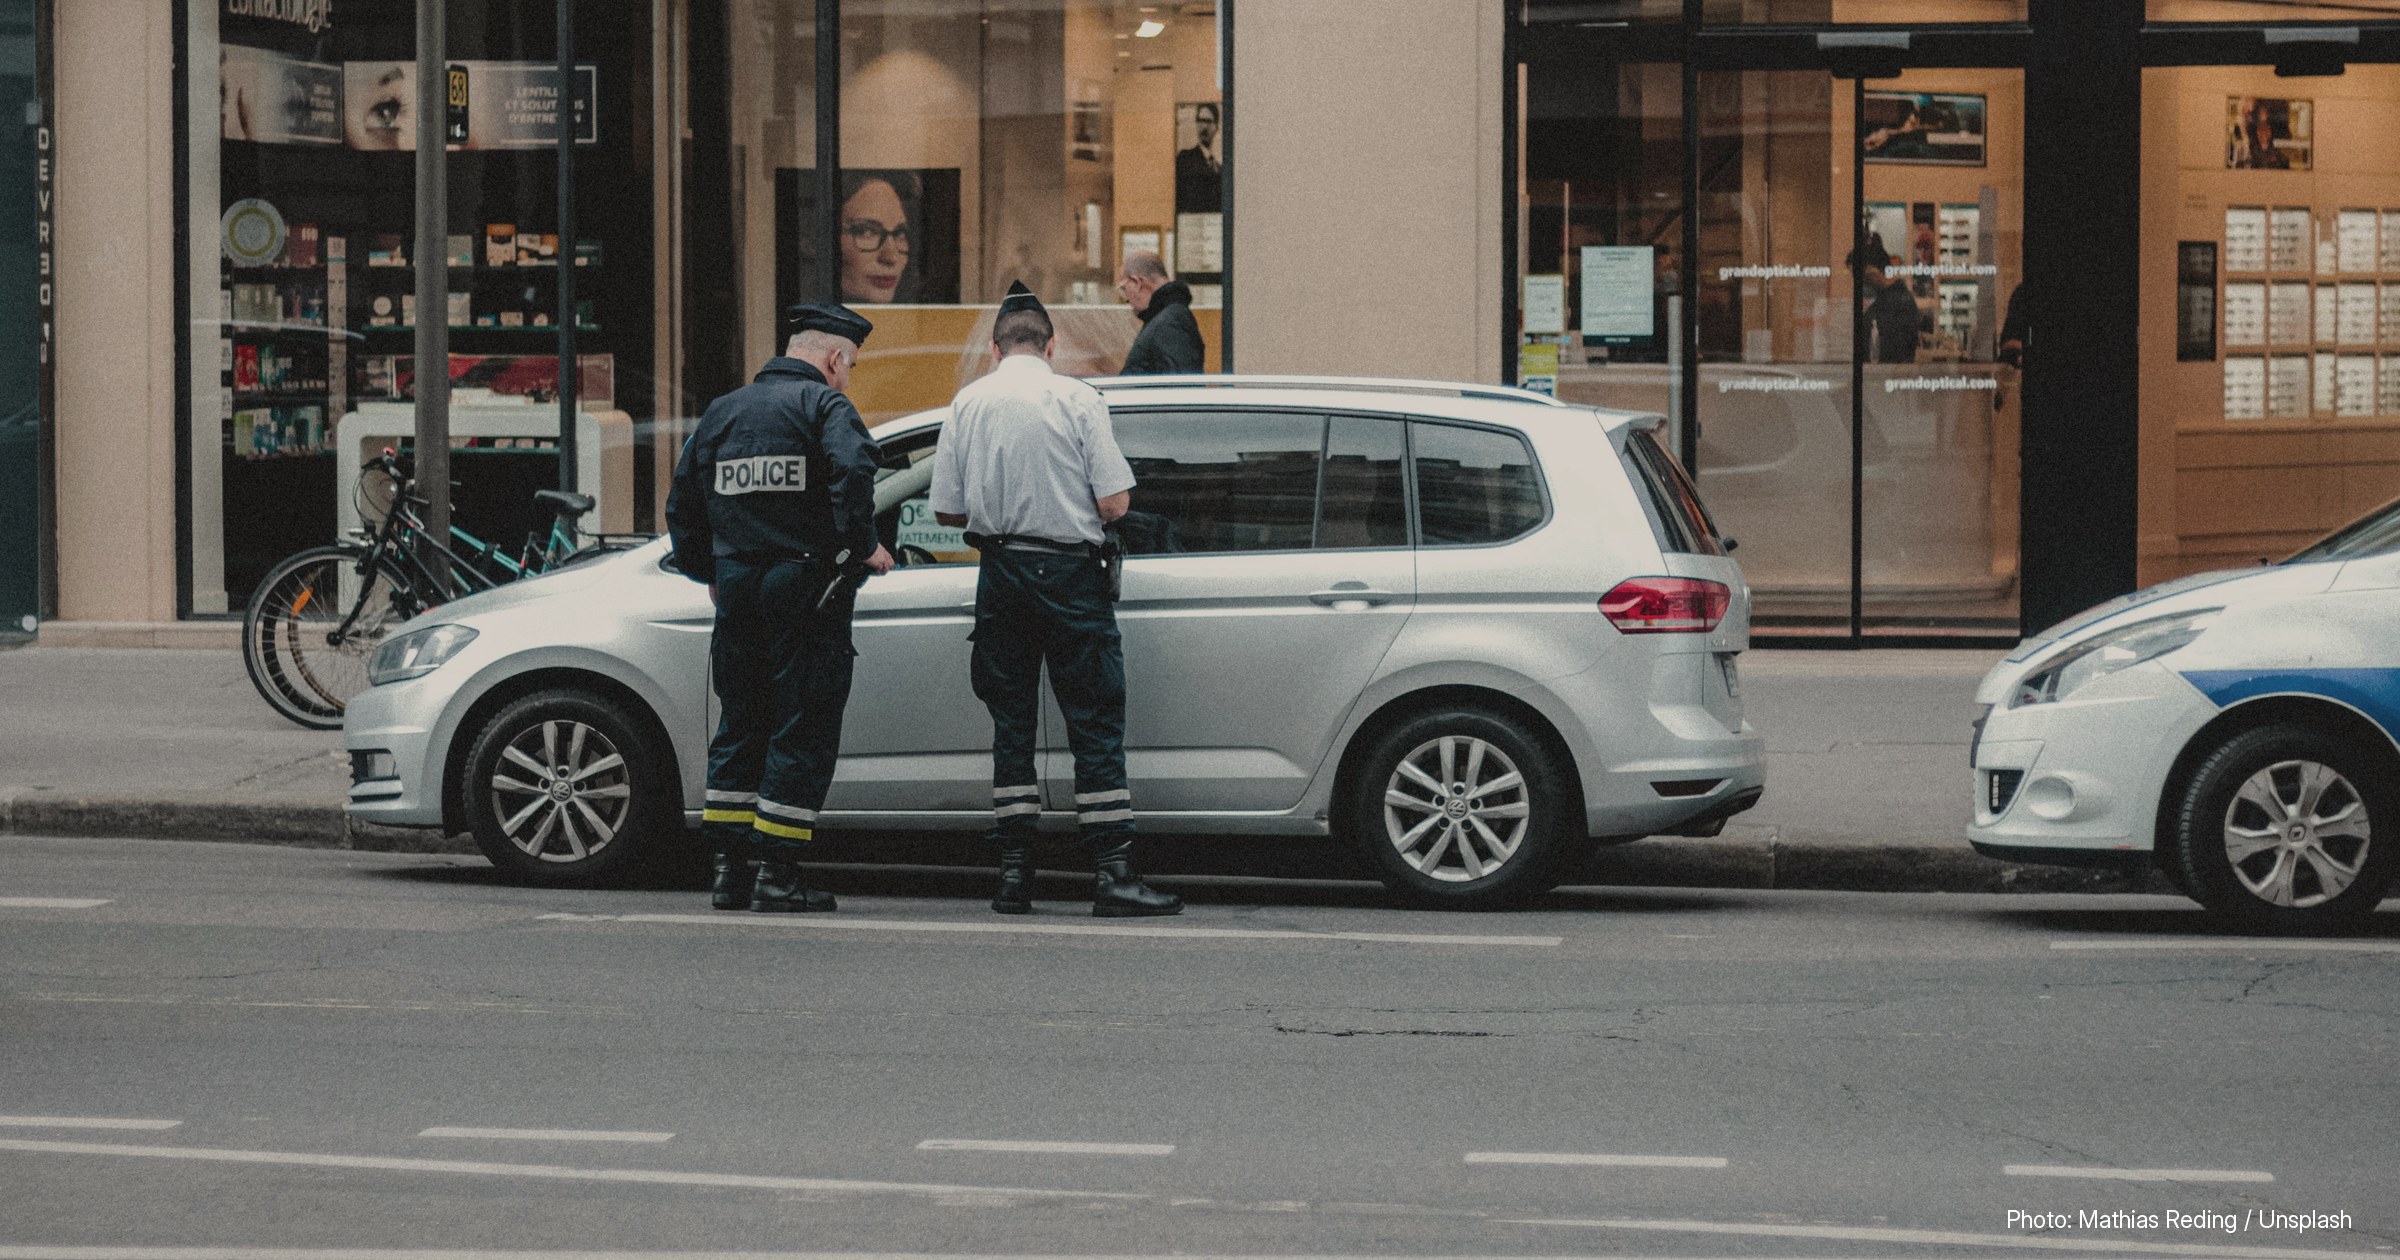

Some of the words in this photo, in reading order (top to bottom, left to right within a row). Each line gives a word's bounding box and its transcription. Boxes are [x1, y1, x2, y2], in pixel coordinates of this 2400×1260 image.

[516, 86, 558, 98] LENTILL
[1719, 264, 1831, 281] grandoptical.com
[1884, 262, 1997, 279] grandoptical.com
[1718, 377, 1830, 393] grandoptical.com
[1884, 376, 1998, 393] grandoptical.com
[721, 460, 800, 490] POLICE
